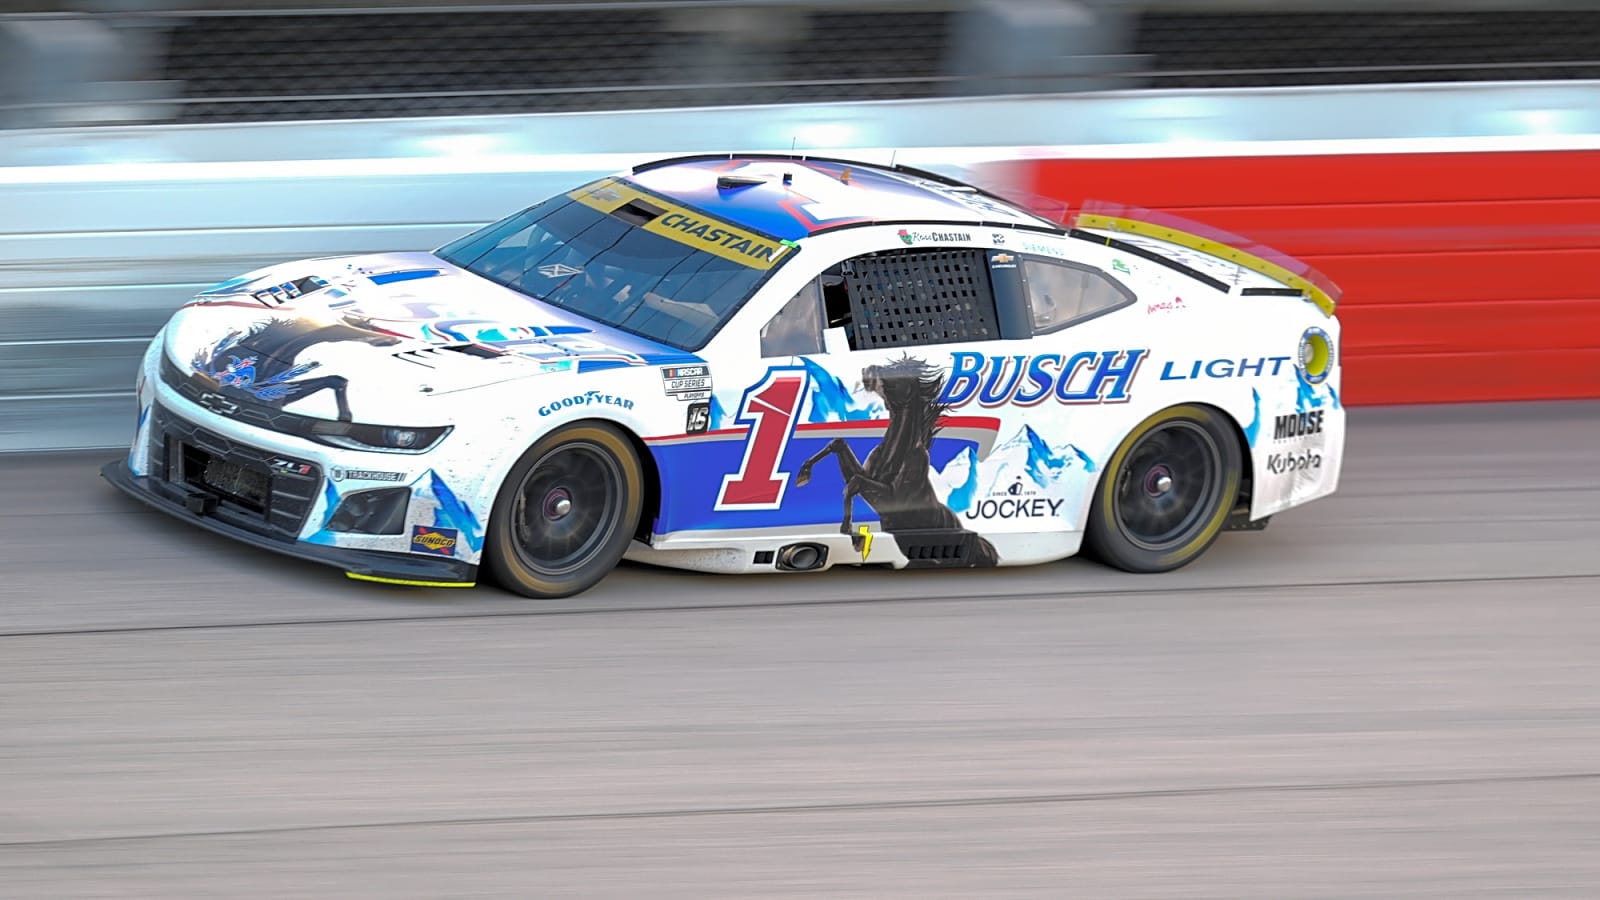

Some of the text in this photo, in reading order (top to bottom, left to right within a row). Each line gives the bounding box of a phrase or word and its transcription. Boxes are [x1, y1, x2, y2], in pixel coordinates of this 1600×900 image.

[660, 213, 775, 263] CHASTAIN
[931, 231, 972, 243] CHASTAIN
[671, 378, 705, 389] CUP SERIES
[677, 367, 703, 378] NASCAR
[938, 349, 1292, 408] BUSCH LIGHT
[538, 391, 635, 416] GOODYEAR
[1273, 409, 1325, 440] MOOSE
[714, 367, 809, 511] 1
[1266, 448, 1322, 475] Kubota
[348, 470, 397, 481] TRACKHOUSE
[965, 498, 1065, 519] JOCKEY
[414, 534, 455, 547] SUNOCO
